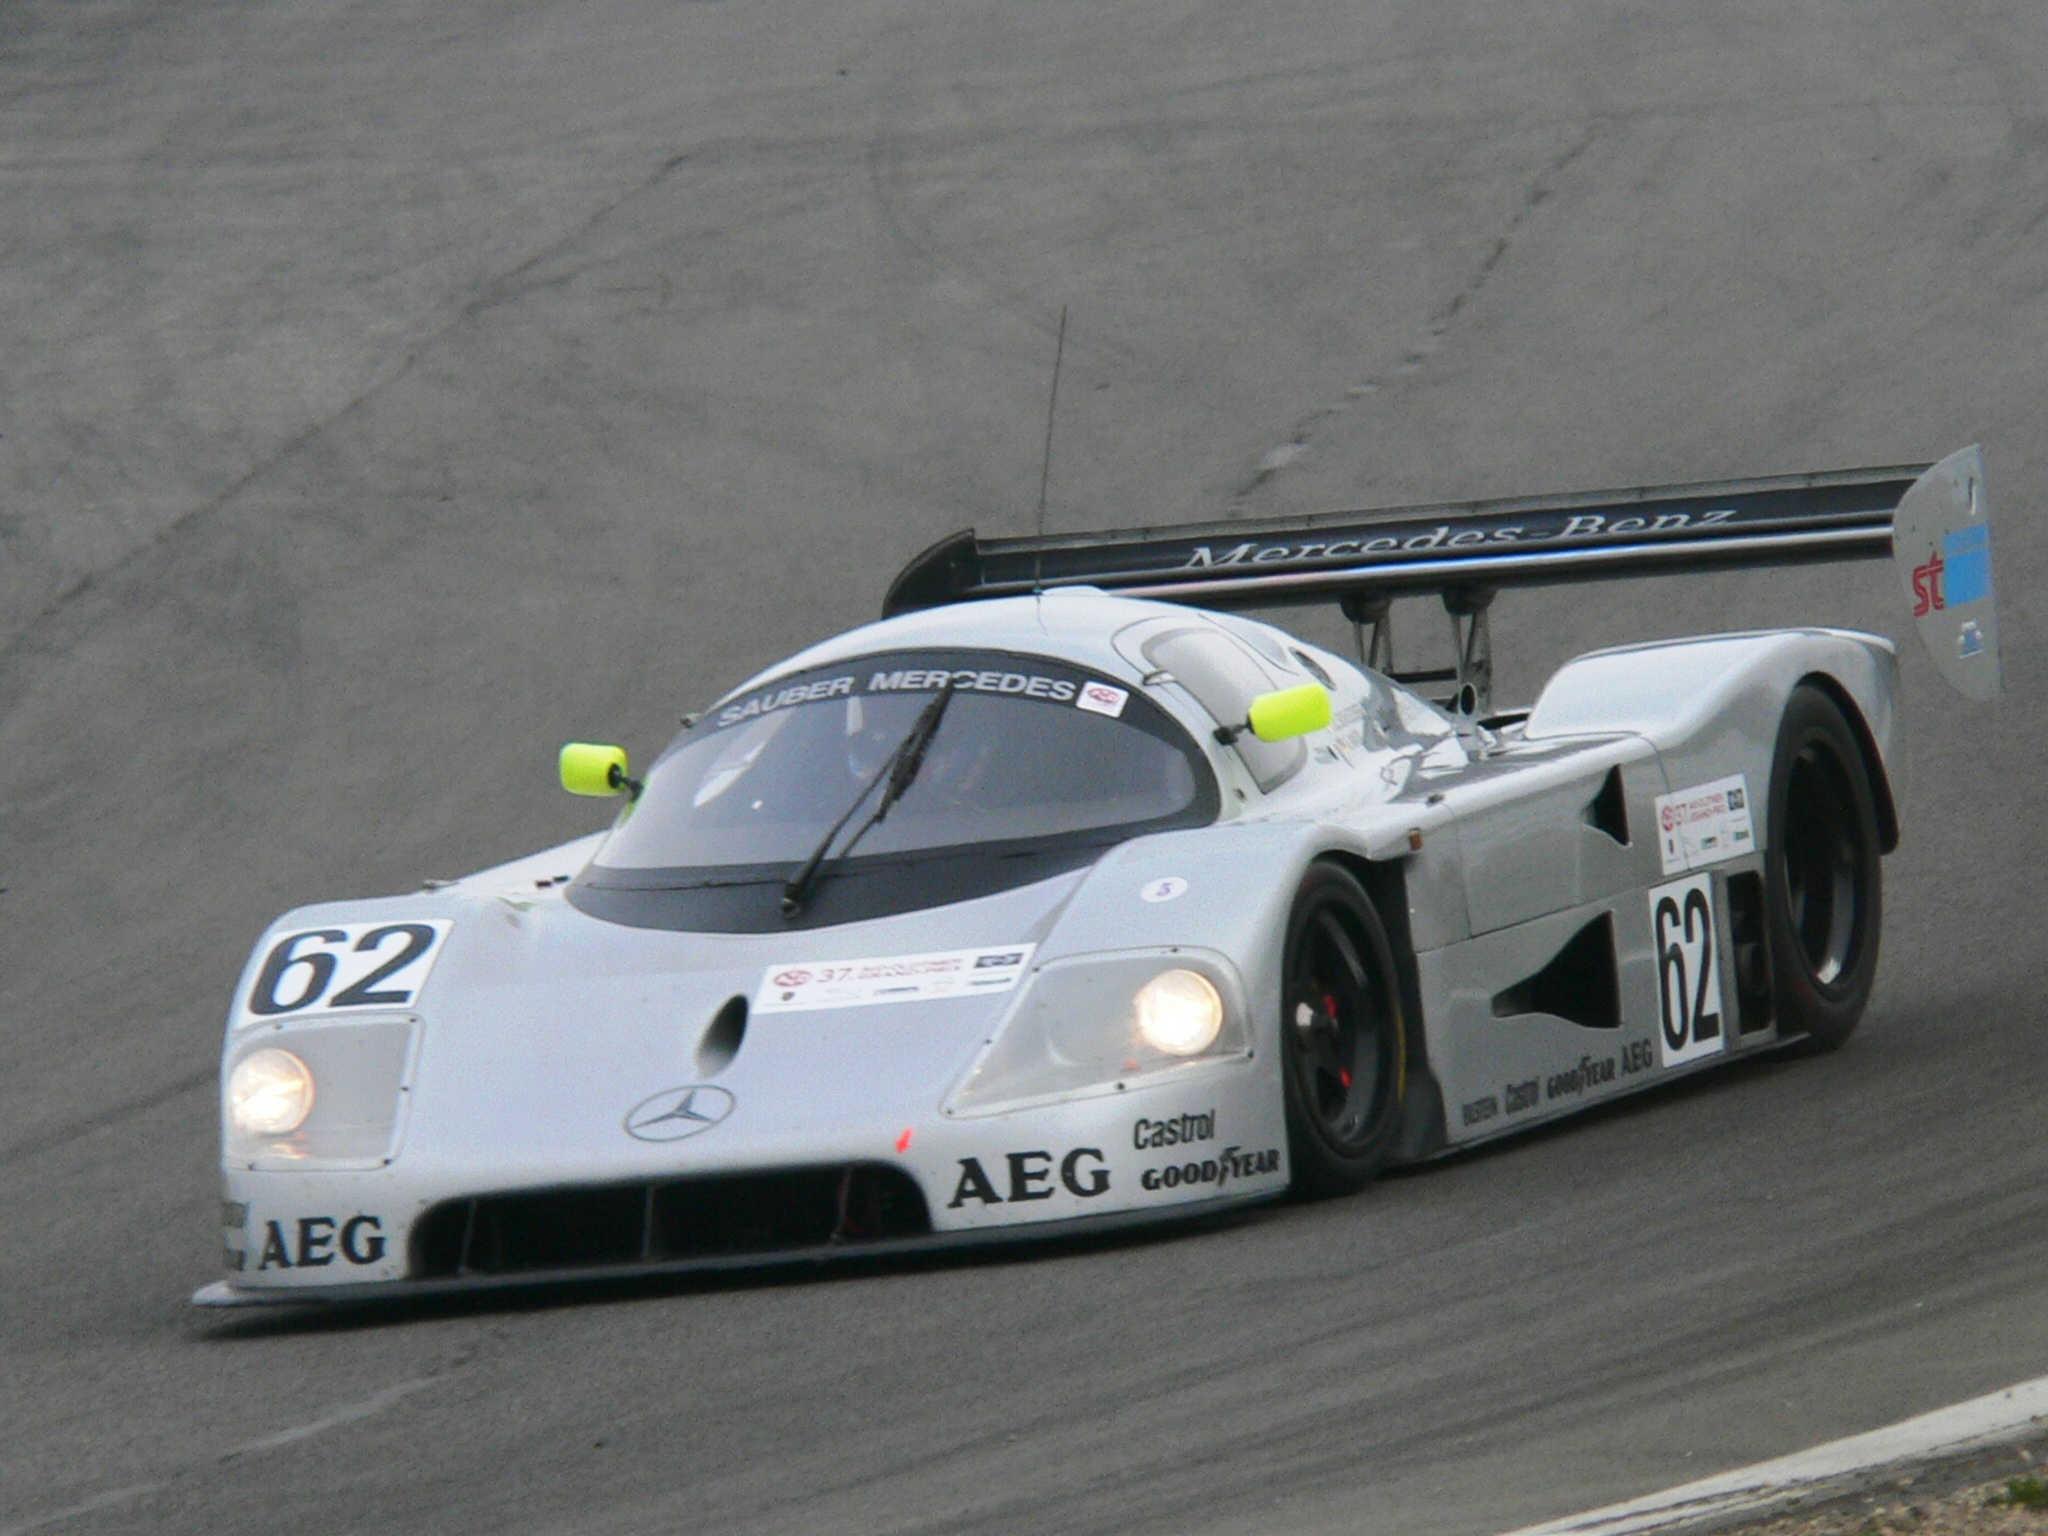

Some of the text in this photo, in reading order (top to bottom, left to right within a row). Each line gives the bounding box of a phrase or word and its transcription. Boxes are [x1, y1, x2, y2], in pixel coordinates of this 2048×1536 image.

[717, 670, 1077, 729] SAUBER MERCEDES
[249, 923, 437, 1016] 62
[1656, 888, 1720, 1051] 62
[1622, 1037, 1653, 1076] AEG
[1134, 1109, 1216, 1151] Castrol
[947, 1147, 1111, 1209] AEG
[1141, 1146, 1280, 1192] GOODYEAR
[258, 1215, 386, 1271] AEG
